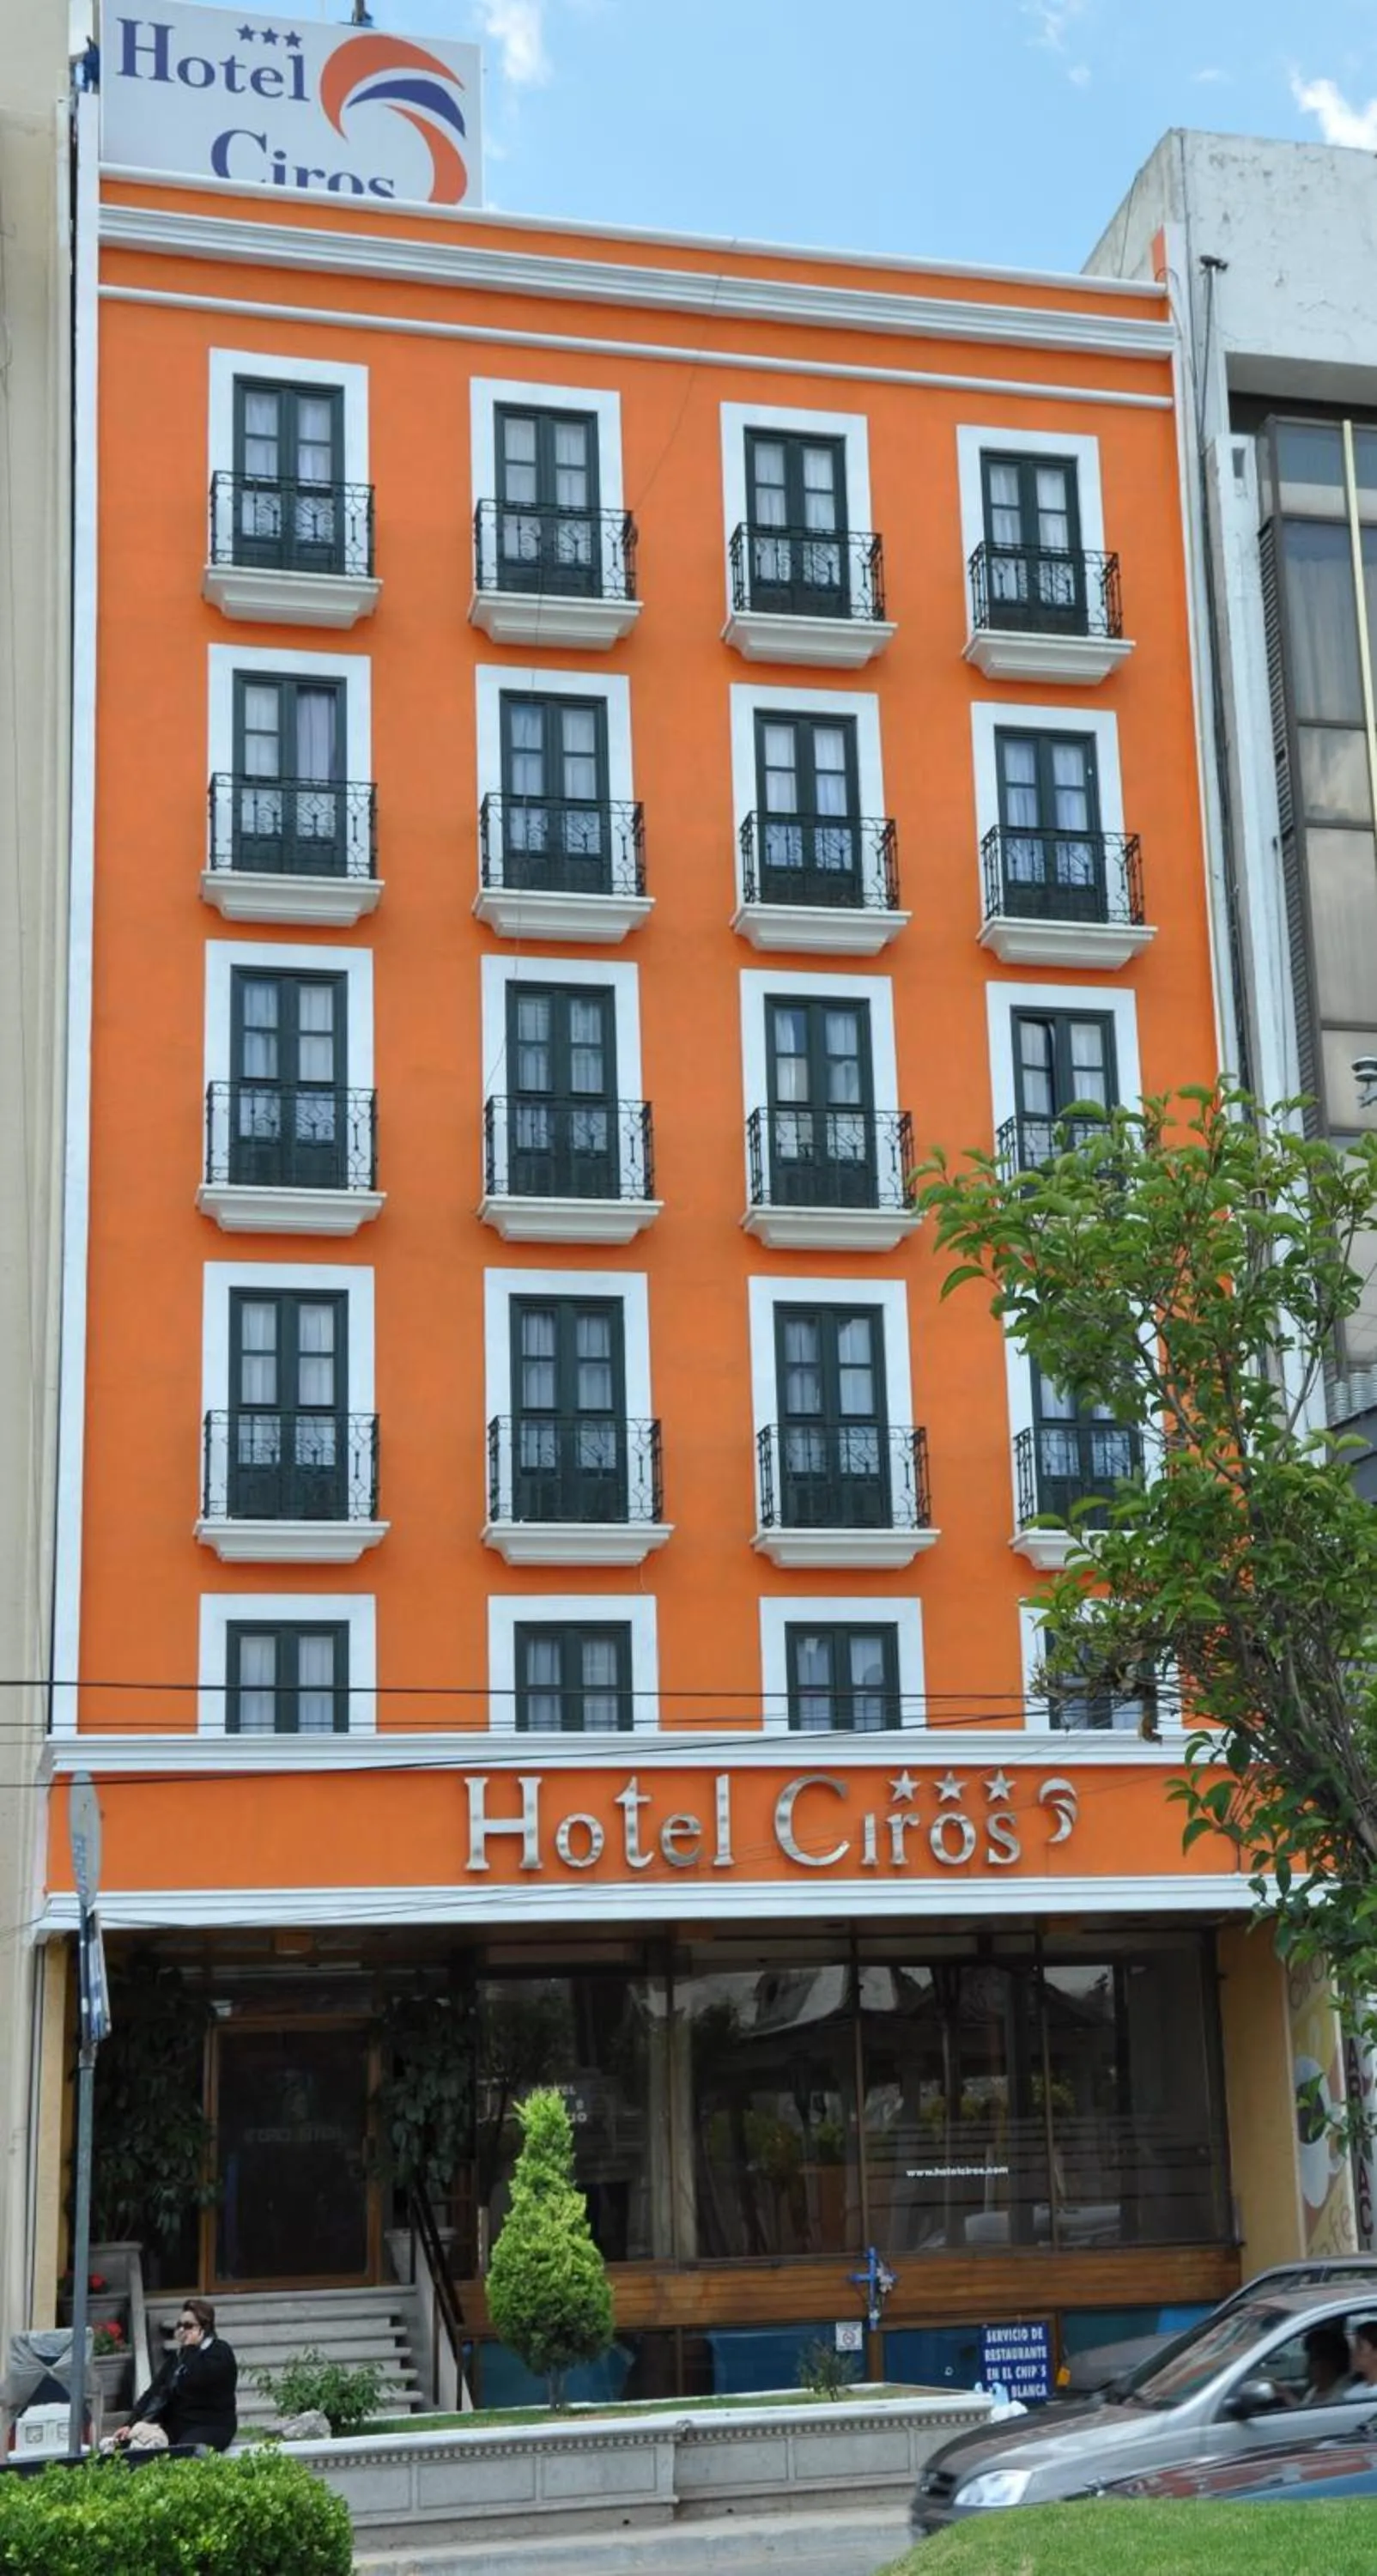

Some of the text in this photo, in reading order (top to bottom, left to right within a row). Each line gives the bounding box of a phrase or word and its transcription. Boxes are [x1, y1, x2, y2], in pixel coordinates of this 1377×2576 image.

[116, 17, 310, 102] Hotel
[210, 129, 395, 198] Ciros
[464, 1774, 1021, 1871] Hotel Ciros
[906, 2166, 1009, 2178] www.hotelciros.com
[986, 2326, 1043, 2342] SERVICIO DE
[985, 2345, 1047, 2361] RESTAURANTE
[986, 2367, 1000, 2381] EN
[1002, 2366, 1013, 2380] EL
[1010, 2382, 1047, 2398] BLANCA
